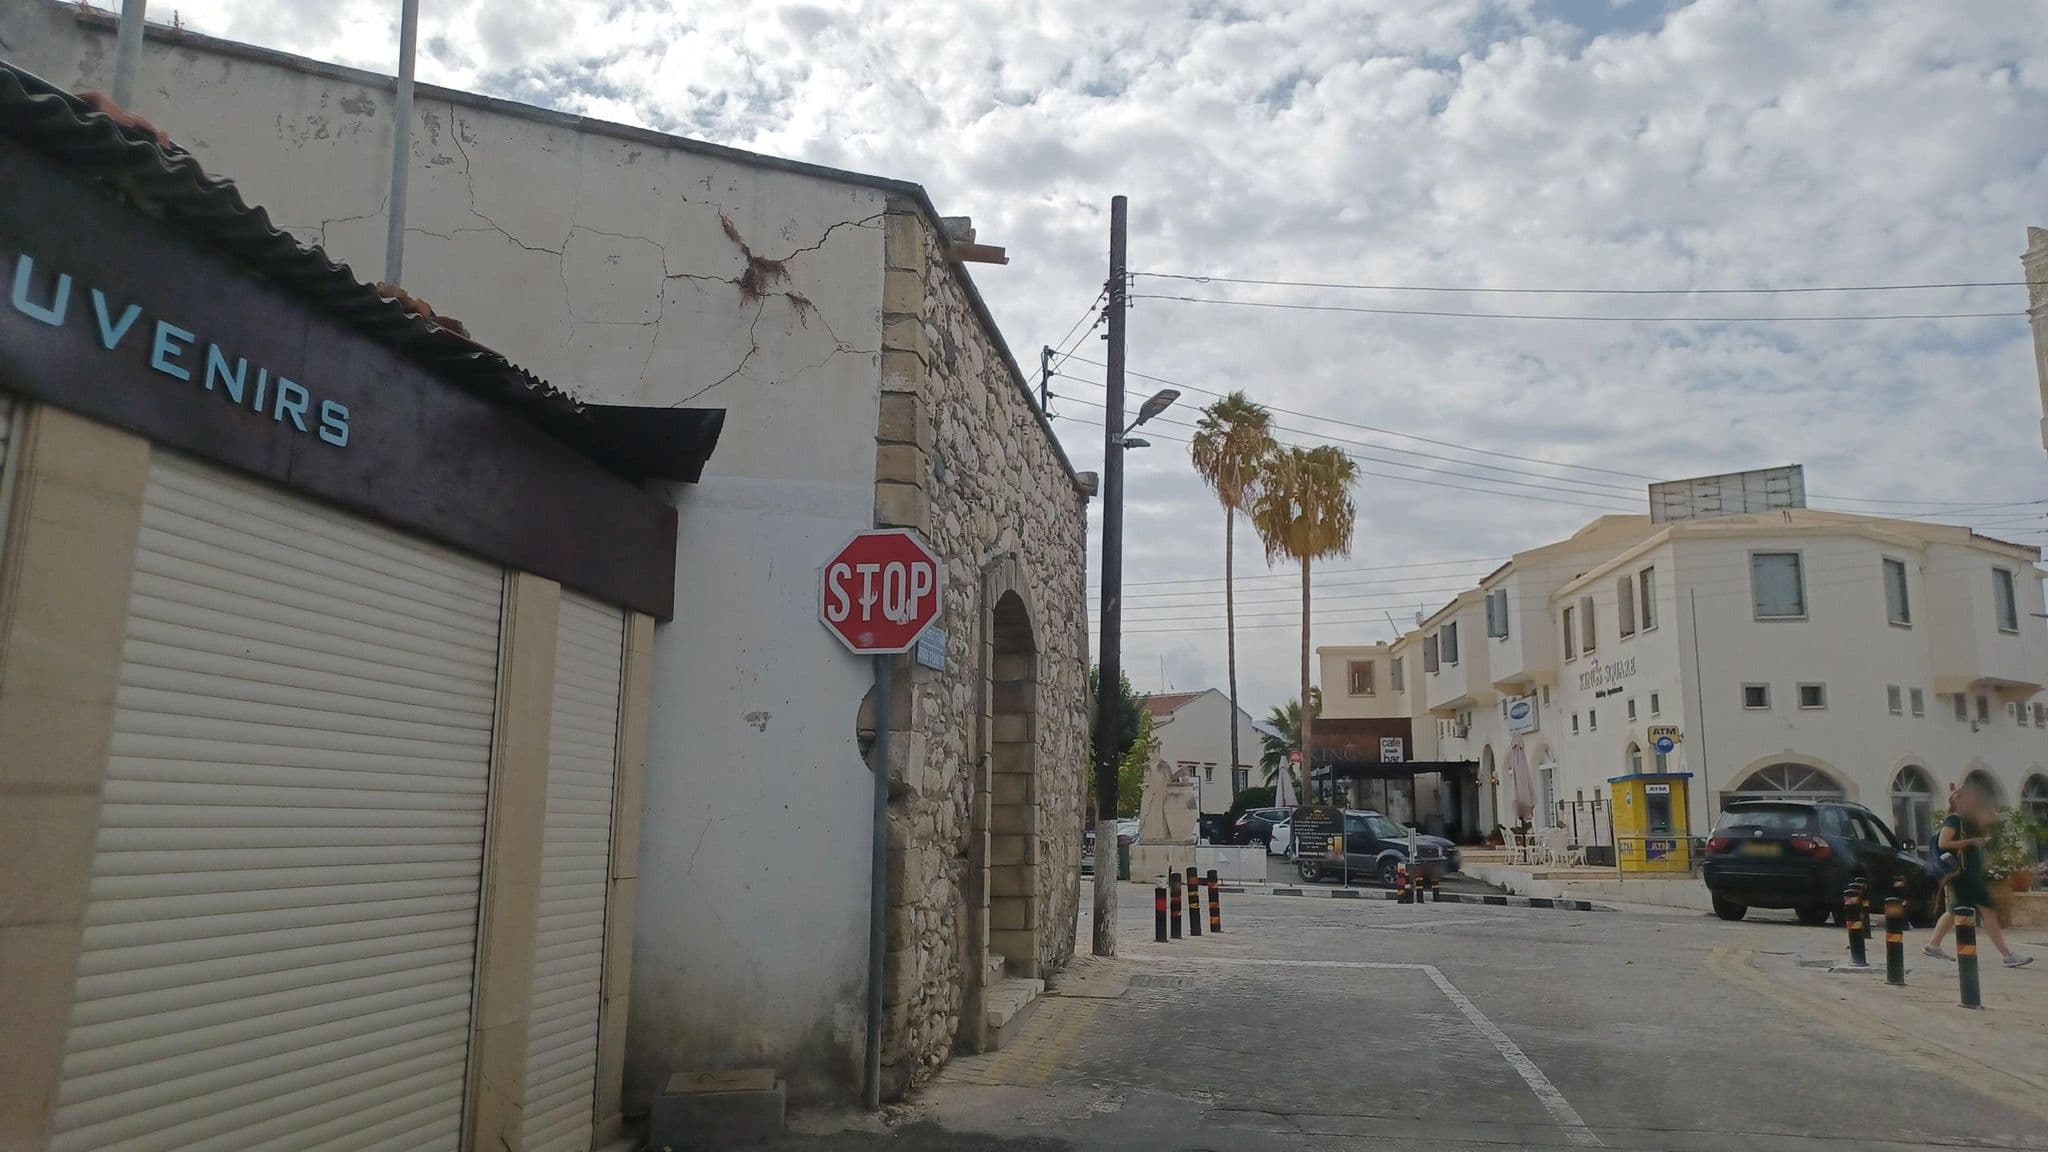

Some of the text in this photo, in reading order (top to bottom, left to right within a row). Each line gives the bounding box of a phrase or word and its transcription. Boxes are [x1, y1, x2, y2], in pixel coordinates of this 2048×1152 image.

[12, 253, 351, 447] UVENIRS
[827, 561, 933, 624] STOP
[1382, 739, 1400, 747] cafe
[1384, 754, 1399, 763] bar
